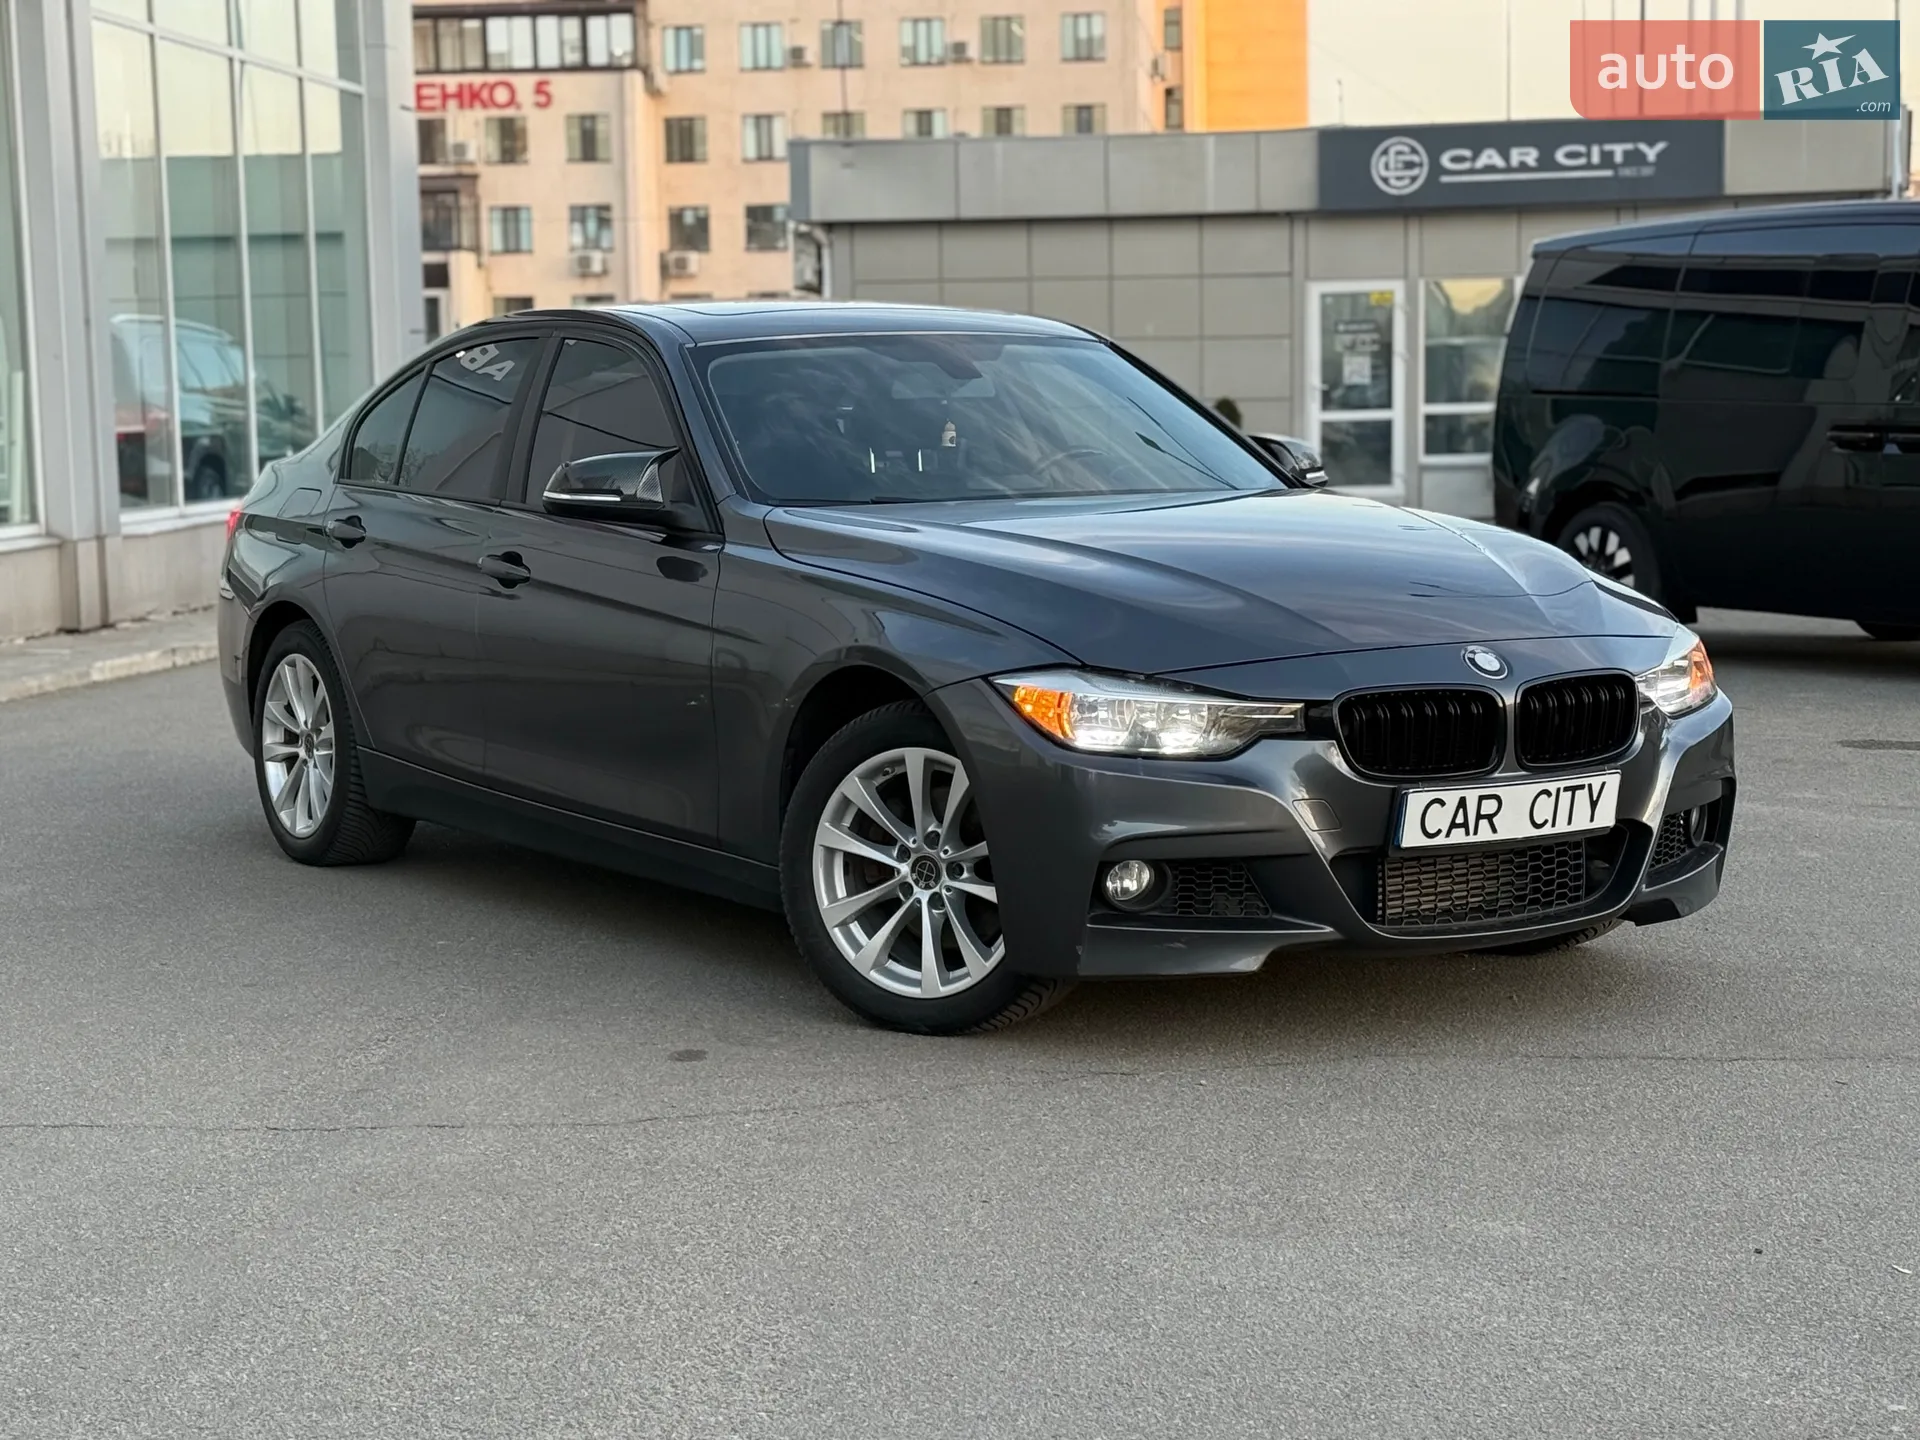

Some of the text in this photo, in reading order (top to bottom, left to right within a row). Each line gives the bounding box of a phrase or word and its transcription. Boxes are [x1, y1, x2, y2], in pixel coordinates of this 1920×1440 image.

[414, 79, 553, 112] ЕНКО, 5
[1439, 141, 1670, 171] CAR CITY
[1419, 780, 1607, 840] CAR CITY
